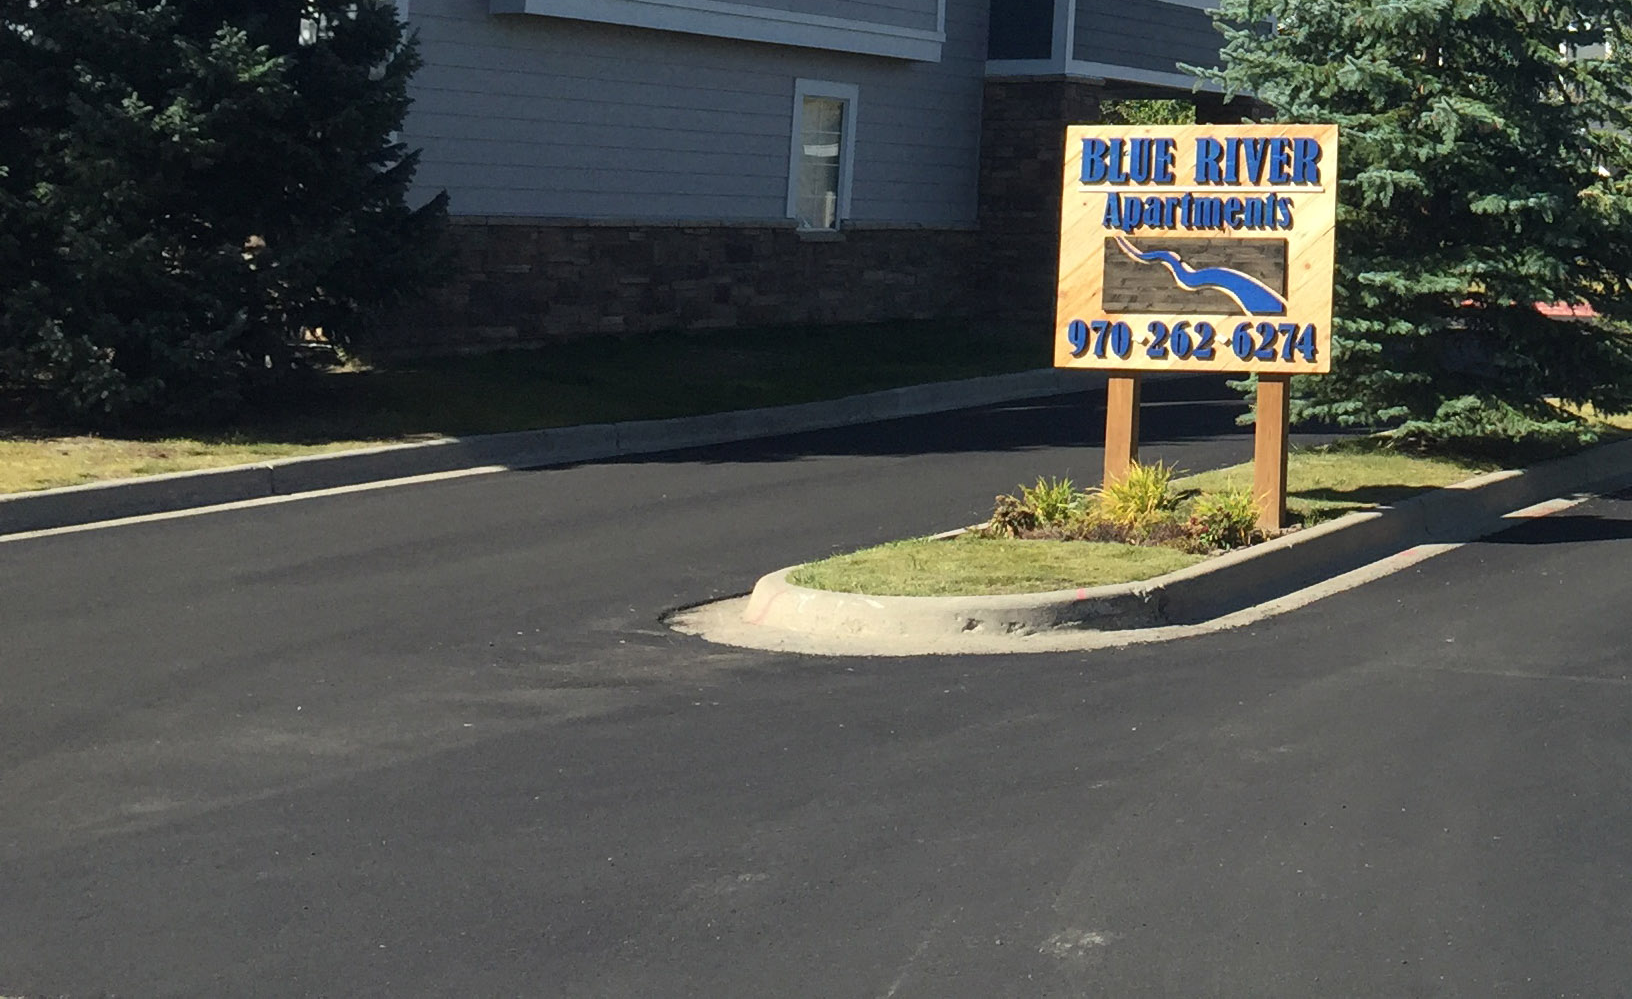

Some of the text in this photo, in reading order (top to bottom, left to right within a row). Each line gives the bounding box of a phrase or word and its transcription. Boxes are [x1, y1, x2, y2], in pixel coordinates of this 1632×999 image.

[1079, 137, 1322, 186] BLUE RIVER
[1102, 191, 1294, 233] Apartments
